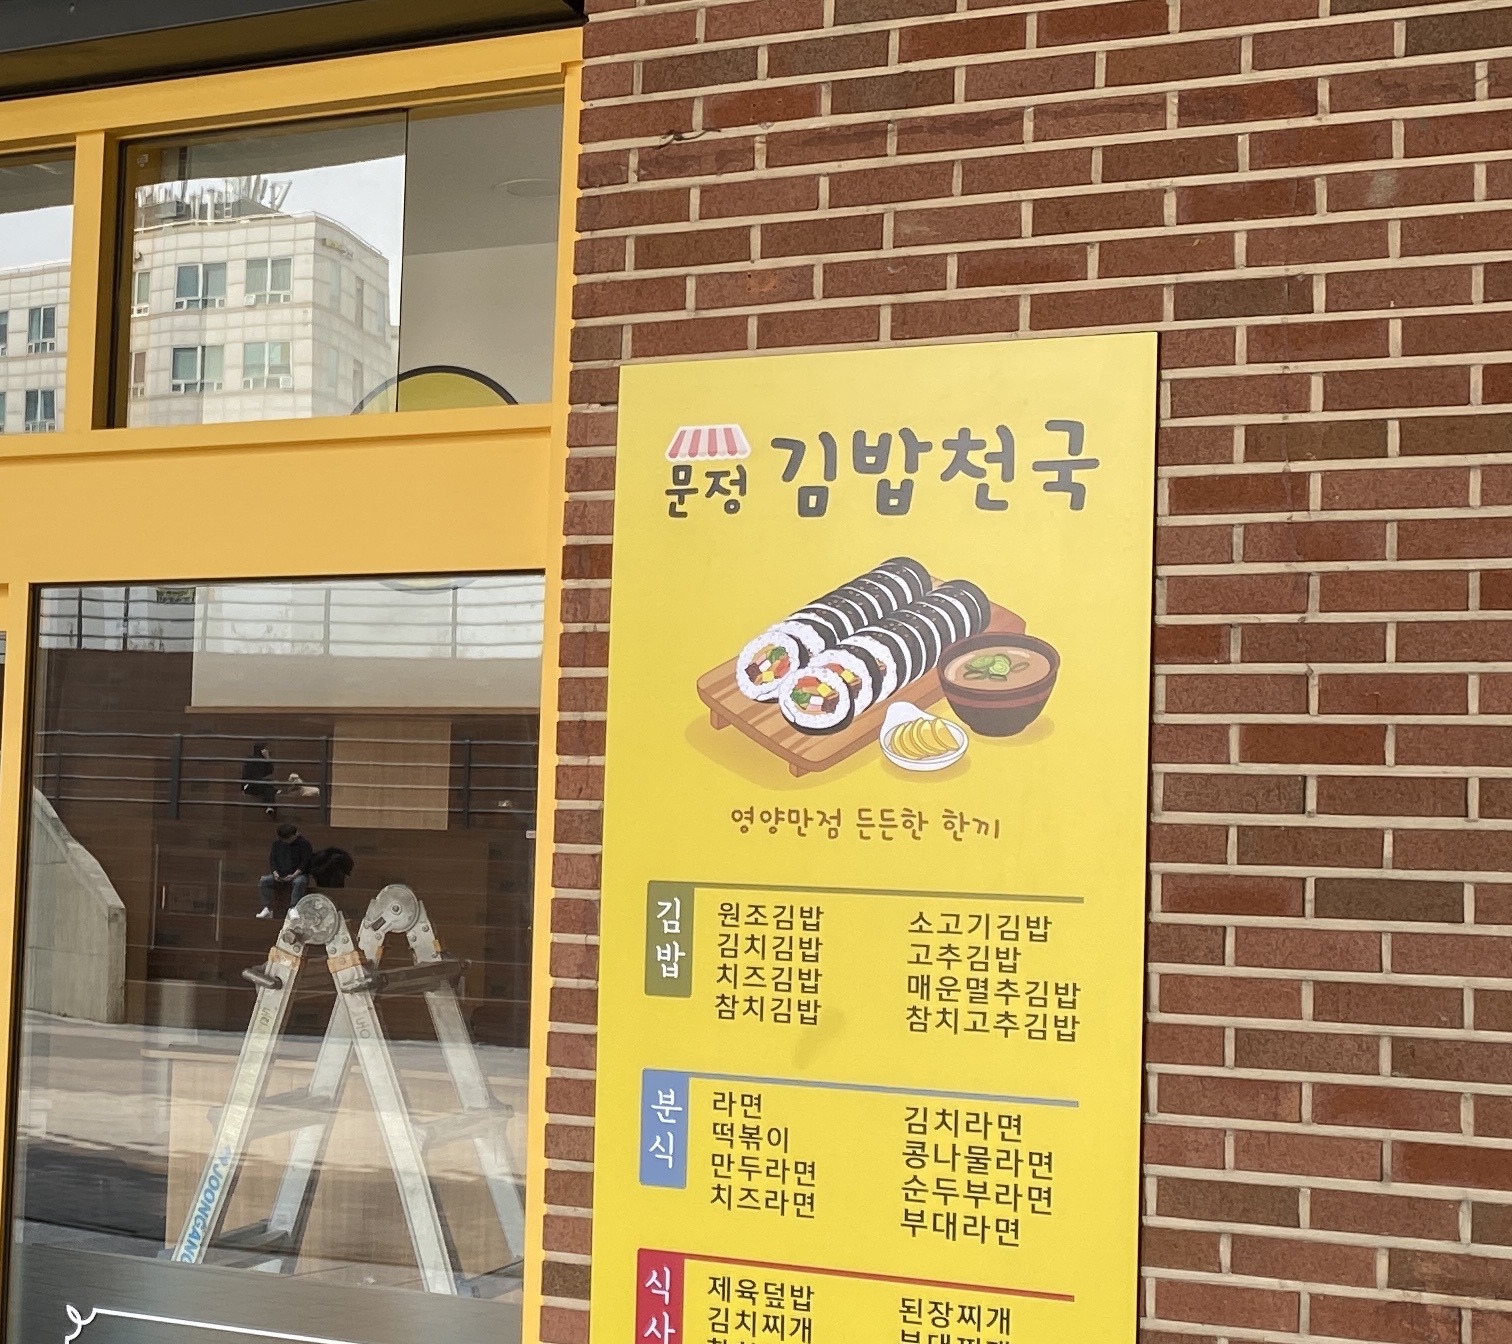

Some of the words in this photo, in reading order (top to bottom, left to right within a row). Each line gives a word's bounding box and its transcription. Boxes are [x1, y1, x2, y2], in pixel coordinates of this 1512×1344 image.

[665, 463, 748, 519] 문정
[769, 419, 1101, 519] 김밥천국
[730, 805, 843, 839] 영양만점
[856, 807, 930, 841] 든든한
[943, 809, 1000, 841] 한끼
[717, 902, 825, 931] 원조김밥
[907, 910, 1052, 943] 소고기김밥
[655, 897, 686, 979] 김밥
[716, 933, 824, 964] 김치김밥
[906, 942, 1021, 976] 고추김밥
[715, 964, 823, 996] 치즈김밥
[906, 974, 1081, 1011] 매운멸추김밥
[714, 994, 822, 1026] 참치김밥
[904, 1005, 1080, 1043] 참치고추김밥
[712, 1092, 763, 1120] 라면
[903, 1105, 1022, 1143] 김치라면
[649, 1088, 683, 1168] 분식
[712, 1122, 790, 1153] 떡볶이
[710, 1153, 816, 1188] 만두라면
[902, 1141, 1054, 1180] 콩나물라면
[709, 1184, 816, 1219] 치즈라면
[900, 1176, 1053, 1215] 순두부라면
[899, 1211, 1020, 1247] 부대라면
[706, 1274, 815, 1312] 제육덮밥
[706, 1306, 814, 1344] 김치찌개
[898, 1297, 1011, 1335] 된장찌개
